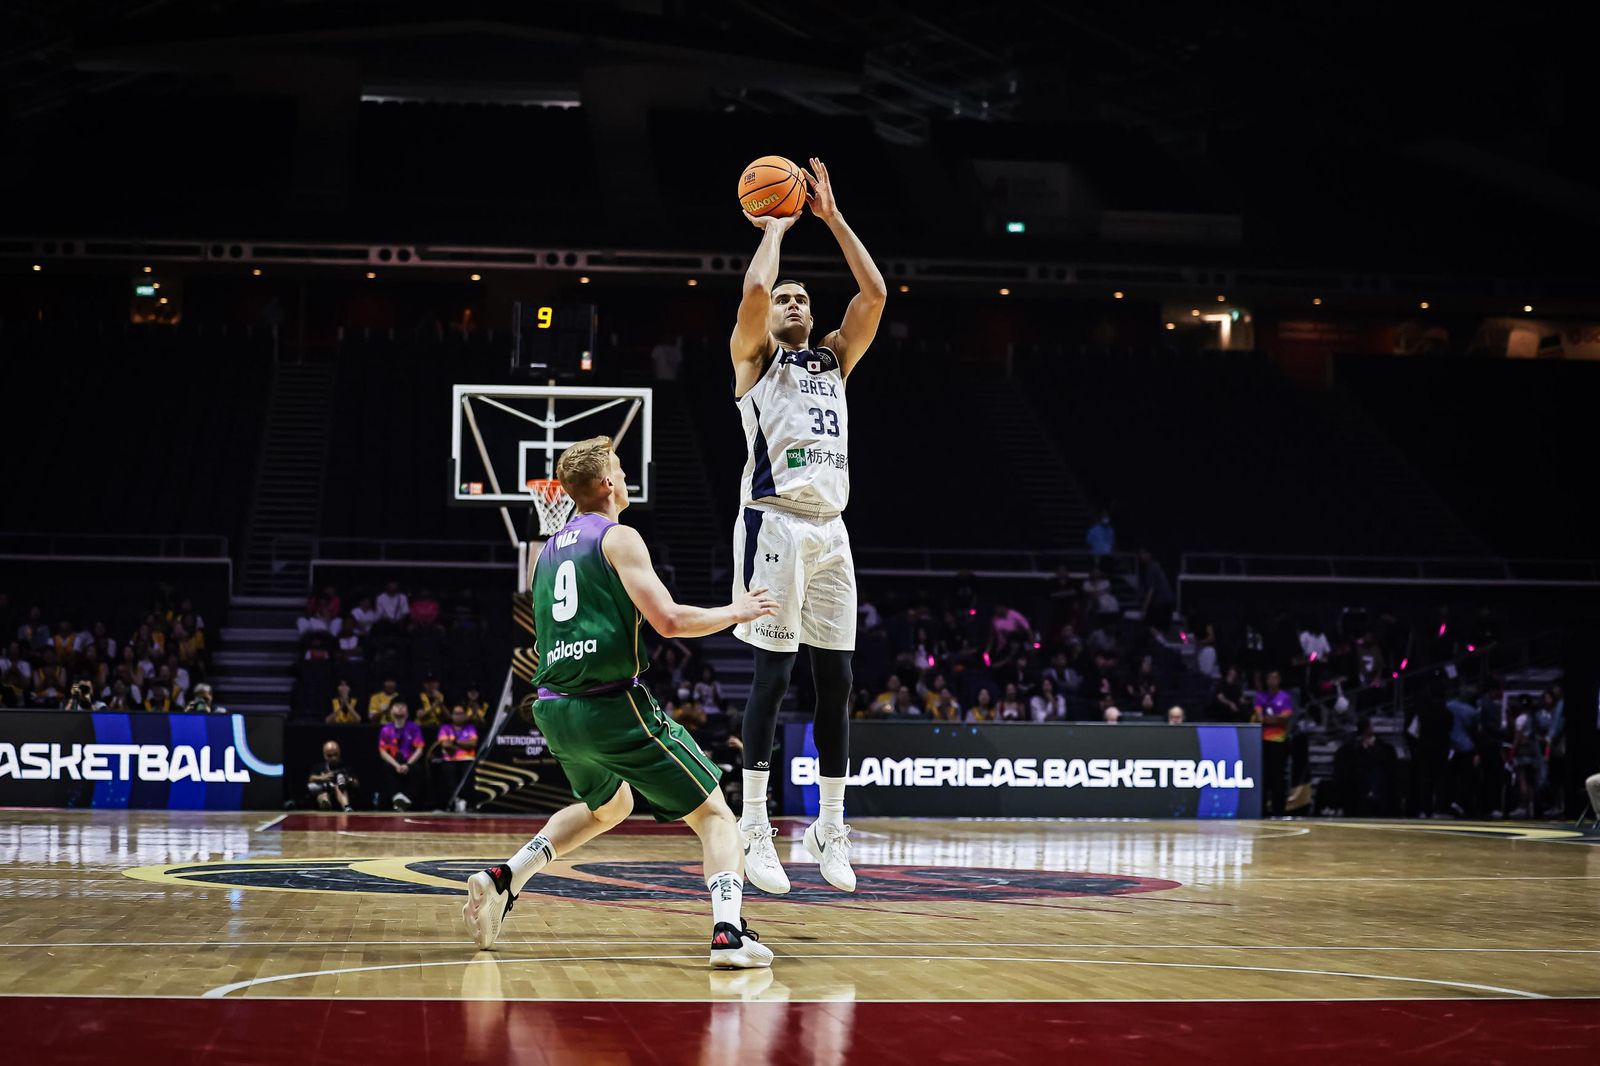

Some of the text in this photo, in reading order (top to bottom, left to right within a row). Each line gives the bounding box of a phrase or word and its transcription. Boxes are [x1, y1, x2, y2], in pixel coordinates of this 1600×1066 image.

[537, 306, 553, 329] 9
[799, 379, 837, 399] BREX
[808, 407, 840, 437] 33
[552, 560, 578, 621] 9
[547, 639, 597, 666] málaga
[526, 746, 543, 756] CUP
[791, 756, 1254, 788] BLAMERICAS.BASKETBALL
